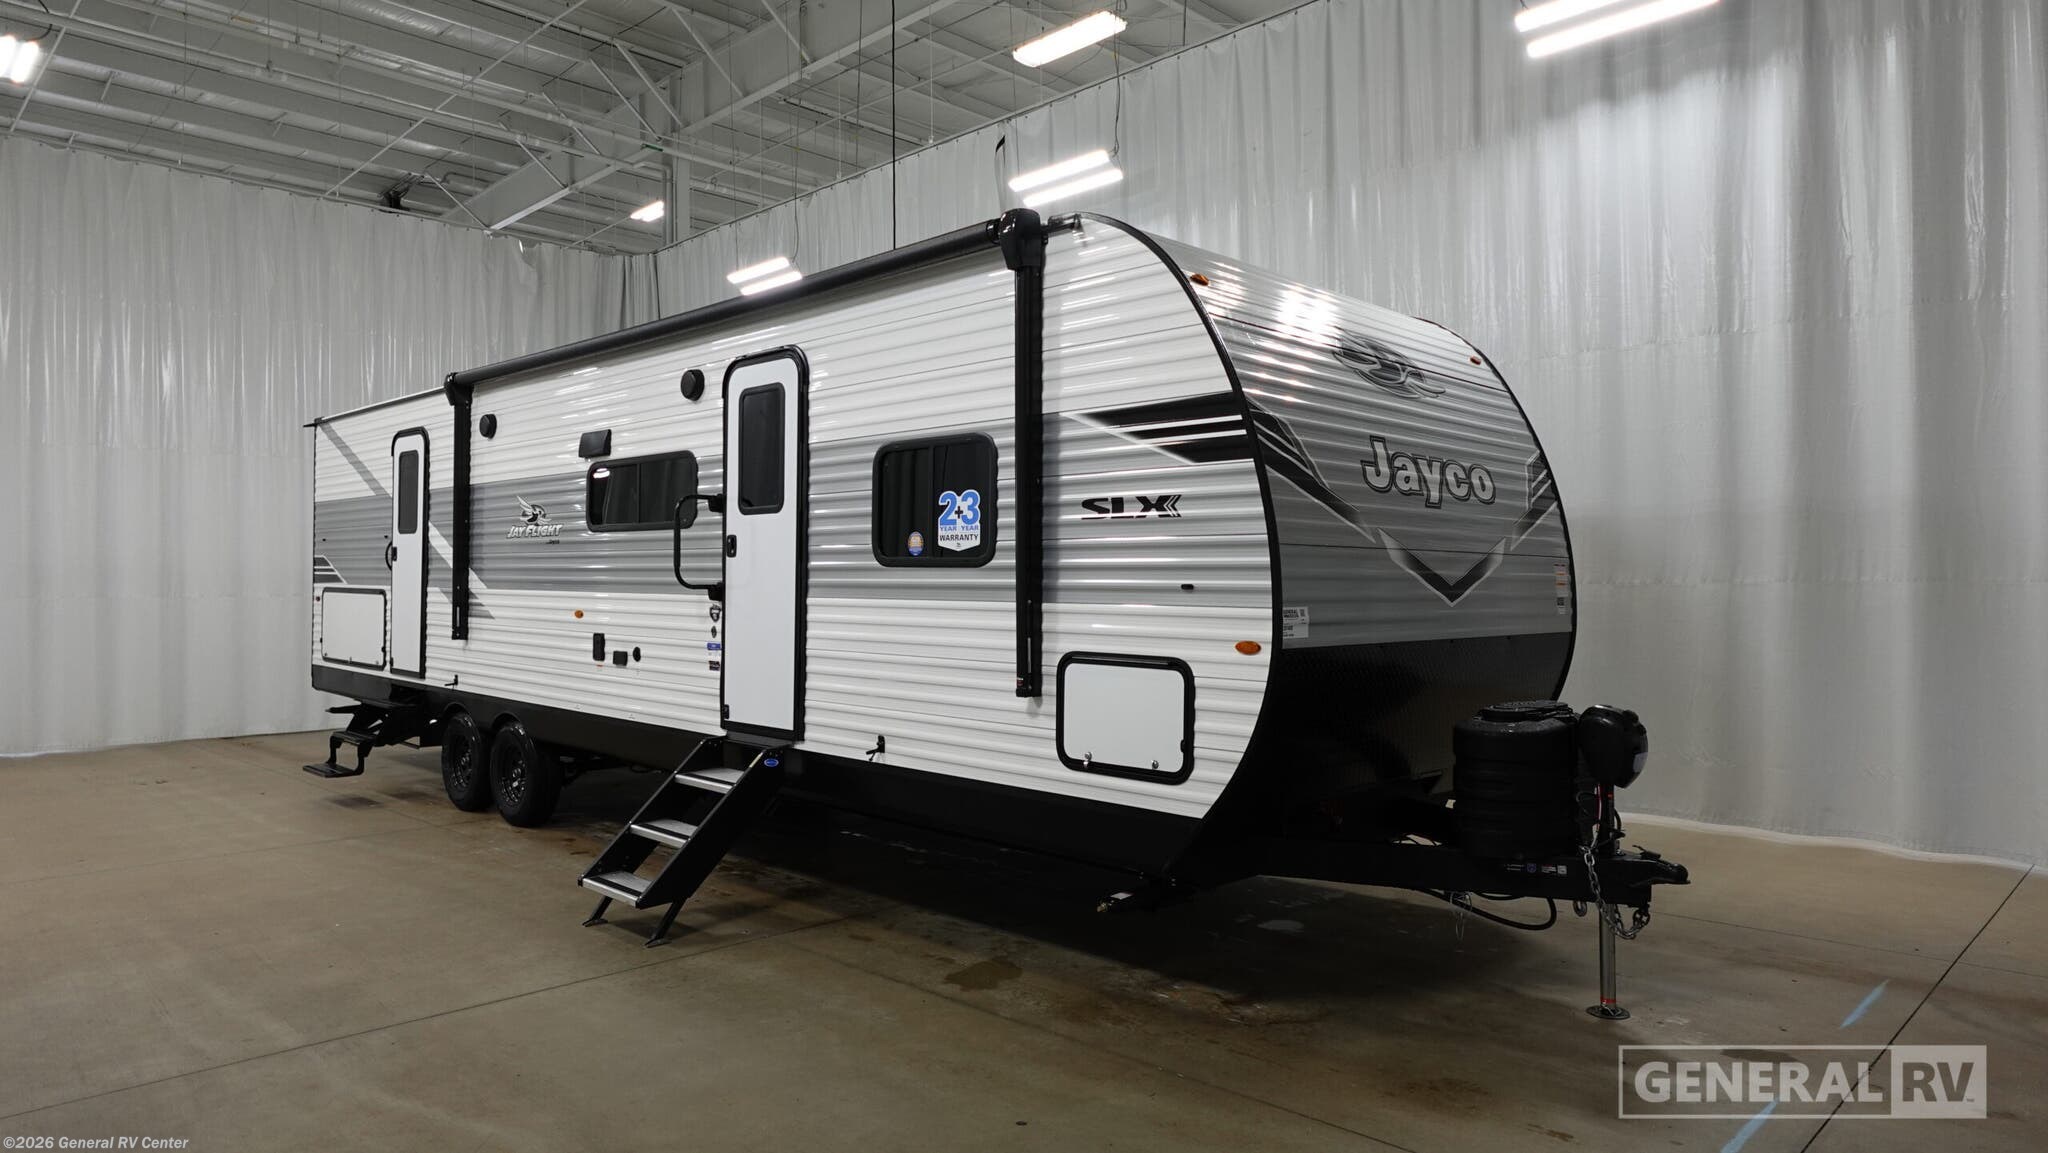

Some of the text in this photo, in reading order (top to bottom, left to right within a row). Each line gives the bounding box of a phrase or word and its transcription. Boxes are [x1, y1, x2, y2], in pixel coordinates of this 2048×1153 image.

[1360, 435, 1496, 509] Jayco
[1081, 494, 1181, 520] SLX
[506, 524, 563, 539] JAY FLIGHT
[939, 533, 979, 541] WARRANTY
